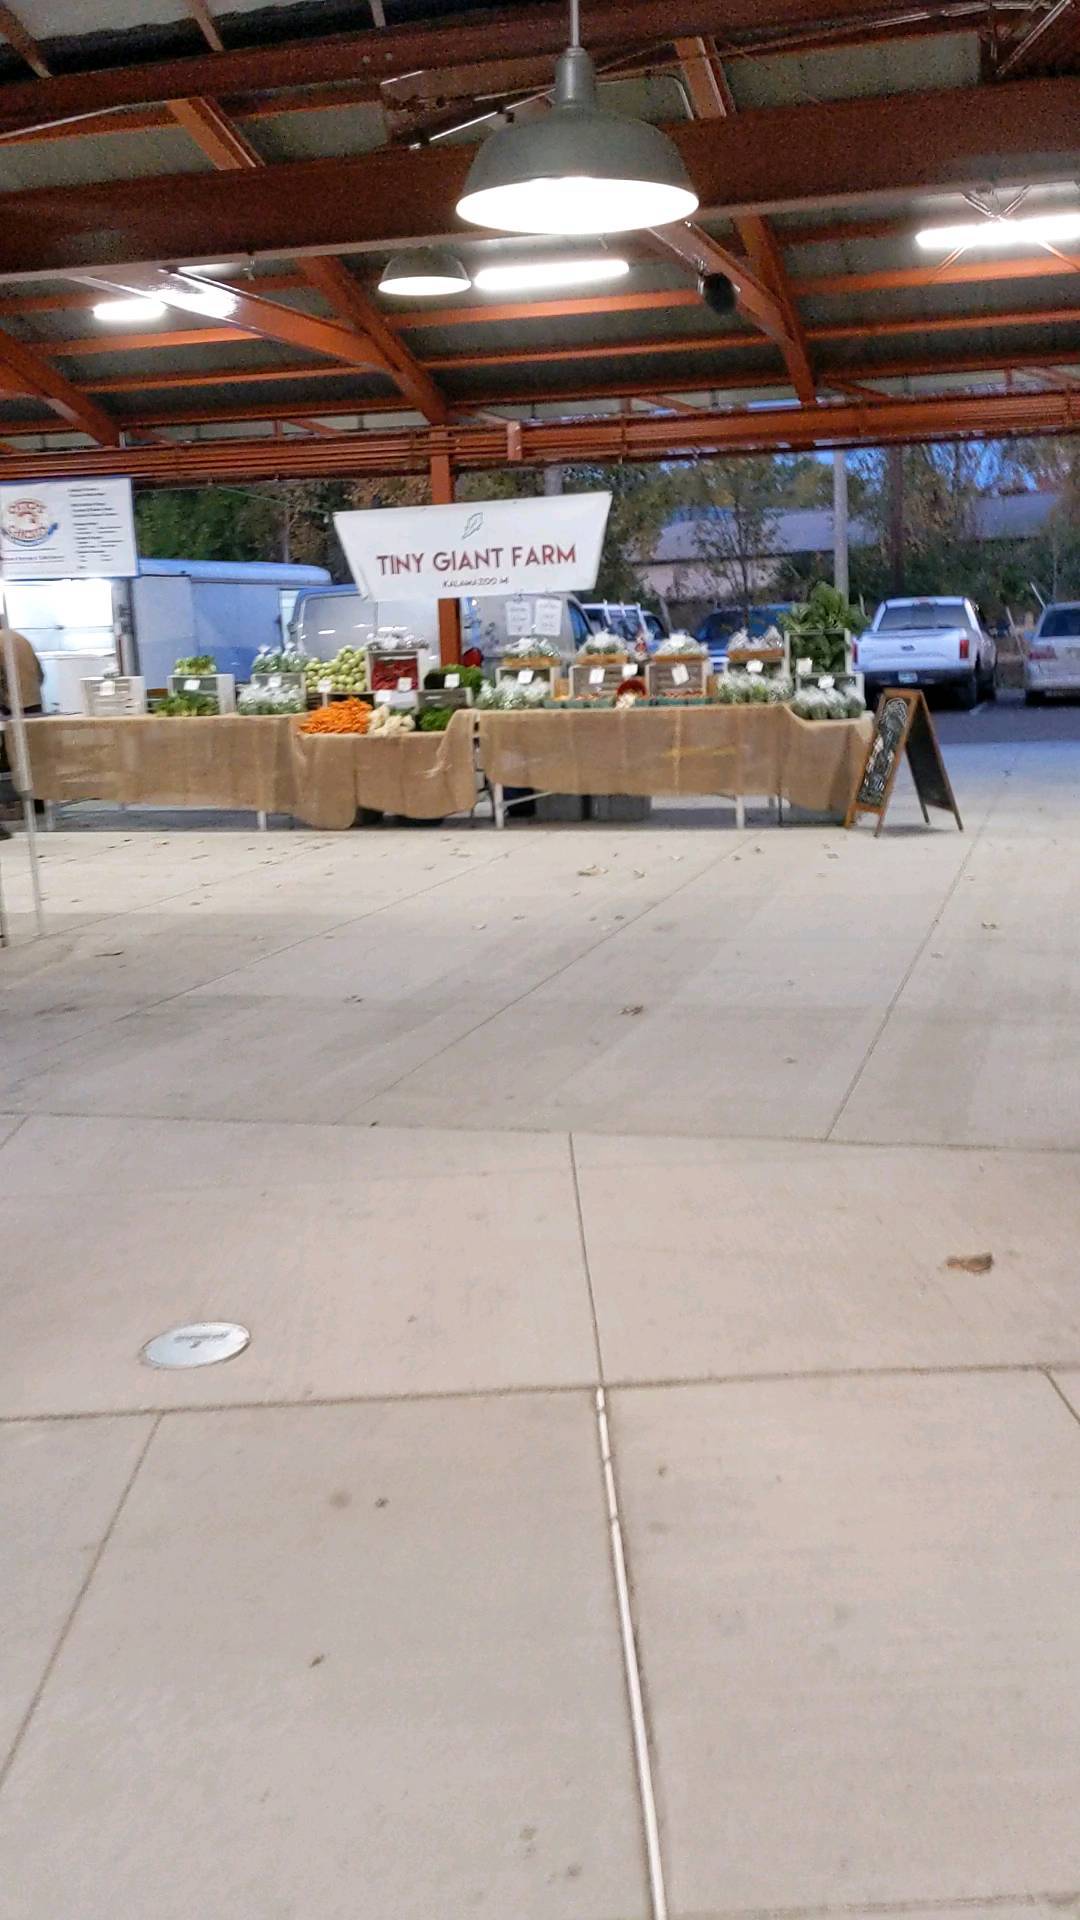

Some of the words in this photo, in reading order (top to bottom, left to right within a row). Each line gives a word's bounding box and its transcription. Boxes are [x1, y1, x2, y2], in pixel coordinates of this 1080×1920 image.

[376, 553, 424, 575] TINY
[433, 548, 504, 571] GIANT
[512, 544, 576, 567] FARM
